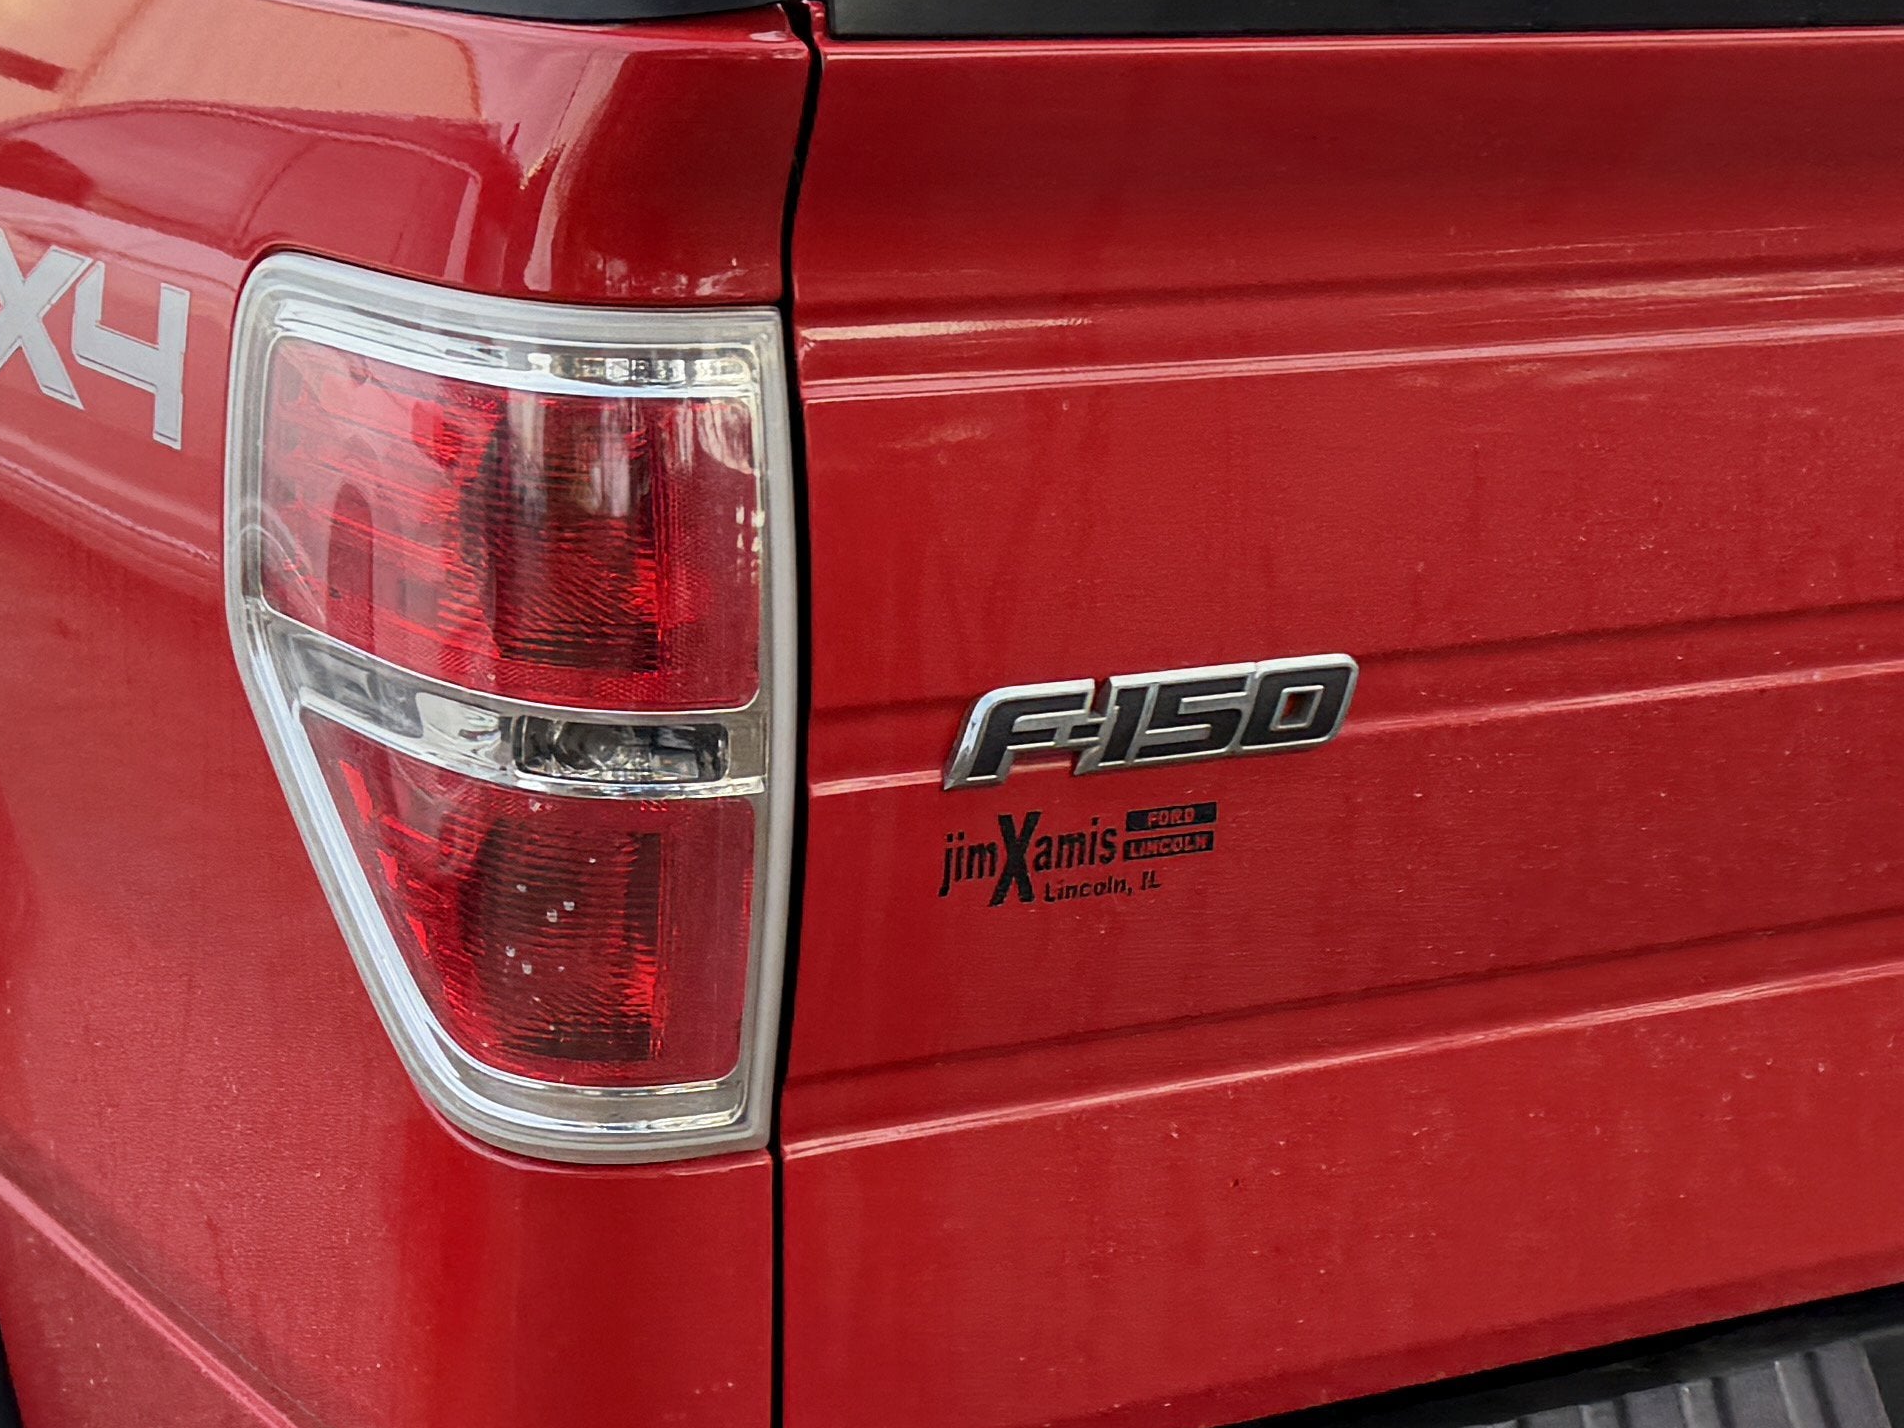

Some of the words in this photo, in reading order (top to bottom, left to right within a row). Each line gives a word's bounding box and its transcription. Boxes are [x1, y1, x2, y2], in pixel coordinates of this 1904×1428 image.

[942, 652, 1360, 791] F-150
[1147, 806, 1195, 827] FORD
[1129, 833, 1210, 857] LINCOLN
[1043, 874, 1133, 903] Lincoln,
[1140, 869, 1162, 891] IL
